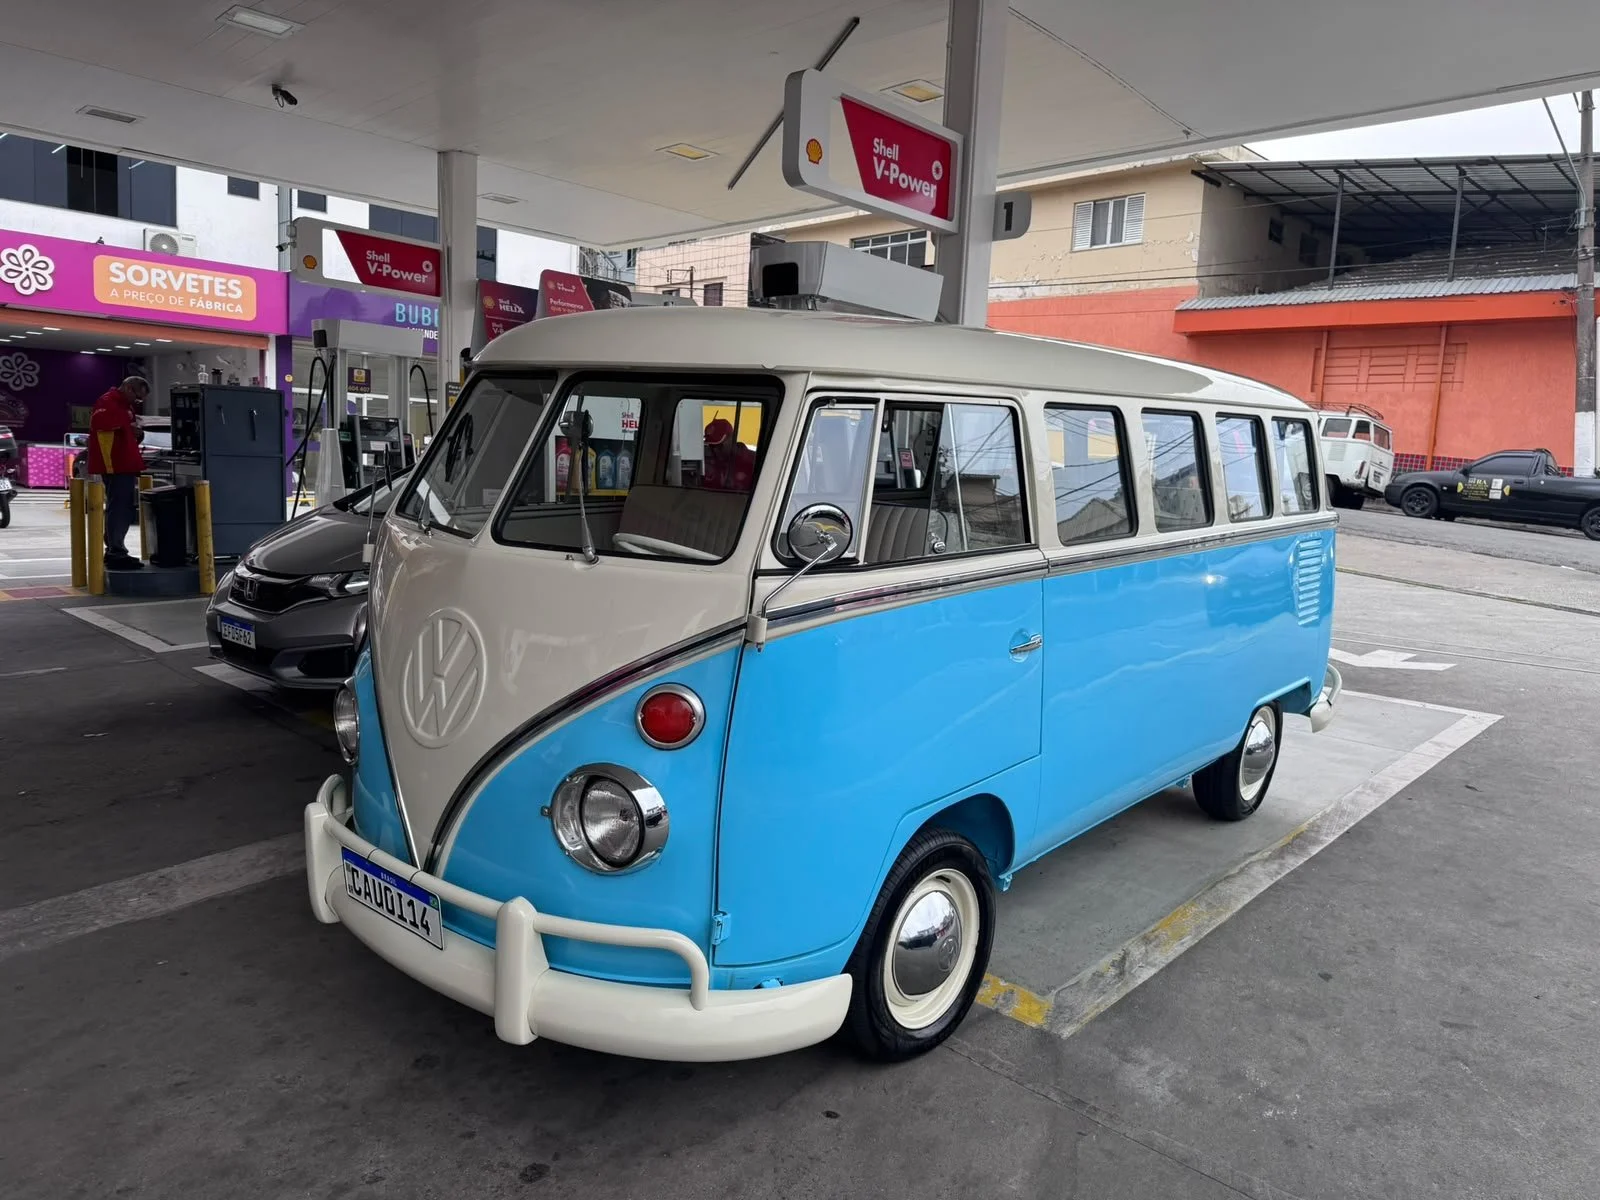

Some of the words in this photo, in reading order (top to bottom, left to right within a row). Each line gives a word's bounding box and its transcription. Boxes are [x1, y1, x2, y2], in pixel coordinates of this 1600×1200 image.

[873, 137, 899, 161] Shell
[873, 156, 937, 198] V-Power
[1003, 201, 1014, 231] 1
[366, 250, 390, 263] Shell
[109, 261, 243, 299] SORVETES
[366, 261, 428, 283] V-Power
[110, 288, 119, 297] A
[123, 289, 165, 304] PREÇO
[169, 295, 185, 305] DE
[189, 296, 243, 313] FÁBRICA
[499, 303, 525, 315] HELIX
